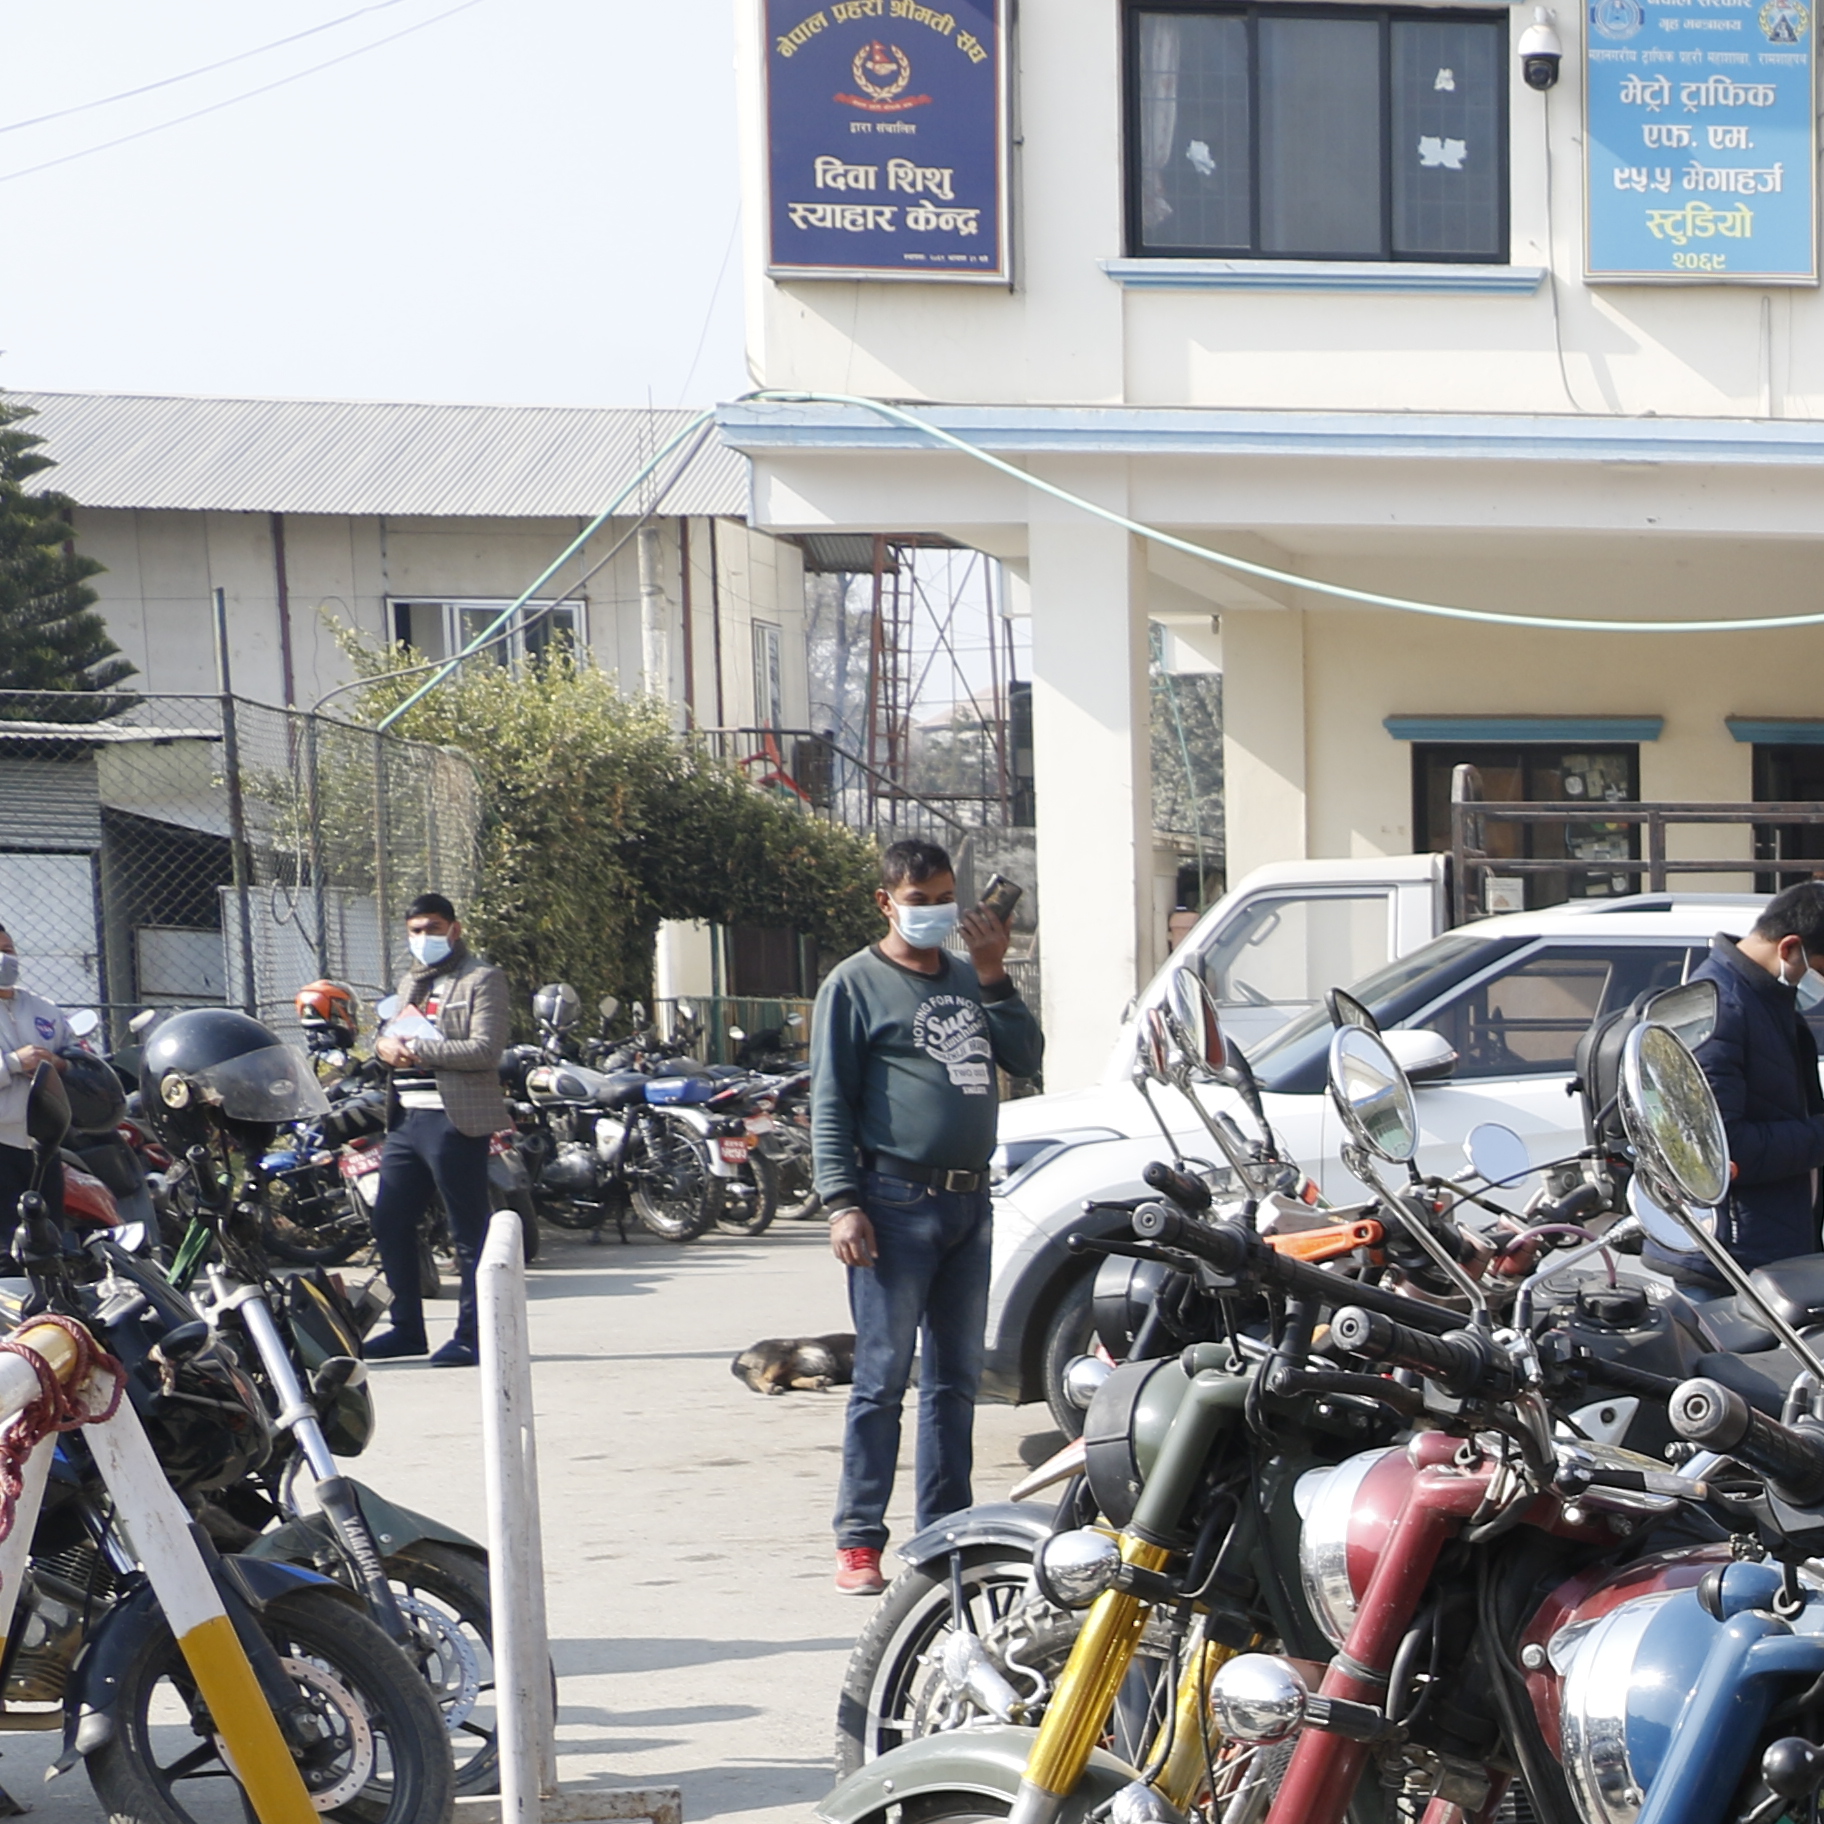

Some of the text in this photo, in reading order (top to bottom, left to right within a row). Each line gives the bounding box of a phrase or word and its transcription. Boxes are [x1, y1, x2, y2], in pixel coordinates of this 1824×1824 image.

[776, 10, 830, 58] नेपाल
[955, 29, 988, 64] संघ
[1619, 74, 1776, 113] मेट्रो ट्राफिक
[1642, 124, 1754, 149] एफ. एम.
[814, 155, 955, 200] दिवा शिशु
[1682, 160, 1784, 194] मेगाहर्ज
[787, 199, 981, 236] स्याहार केन्द्र
[1645, 200, 1754, 245] स्टुडियो
[342, 1515, 382, 1582] YAMAHA
